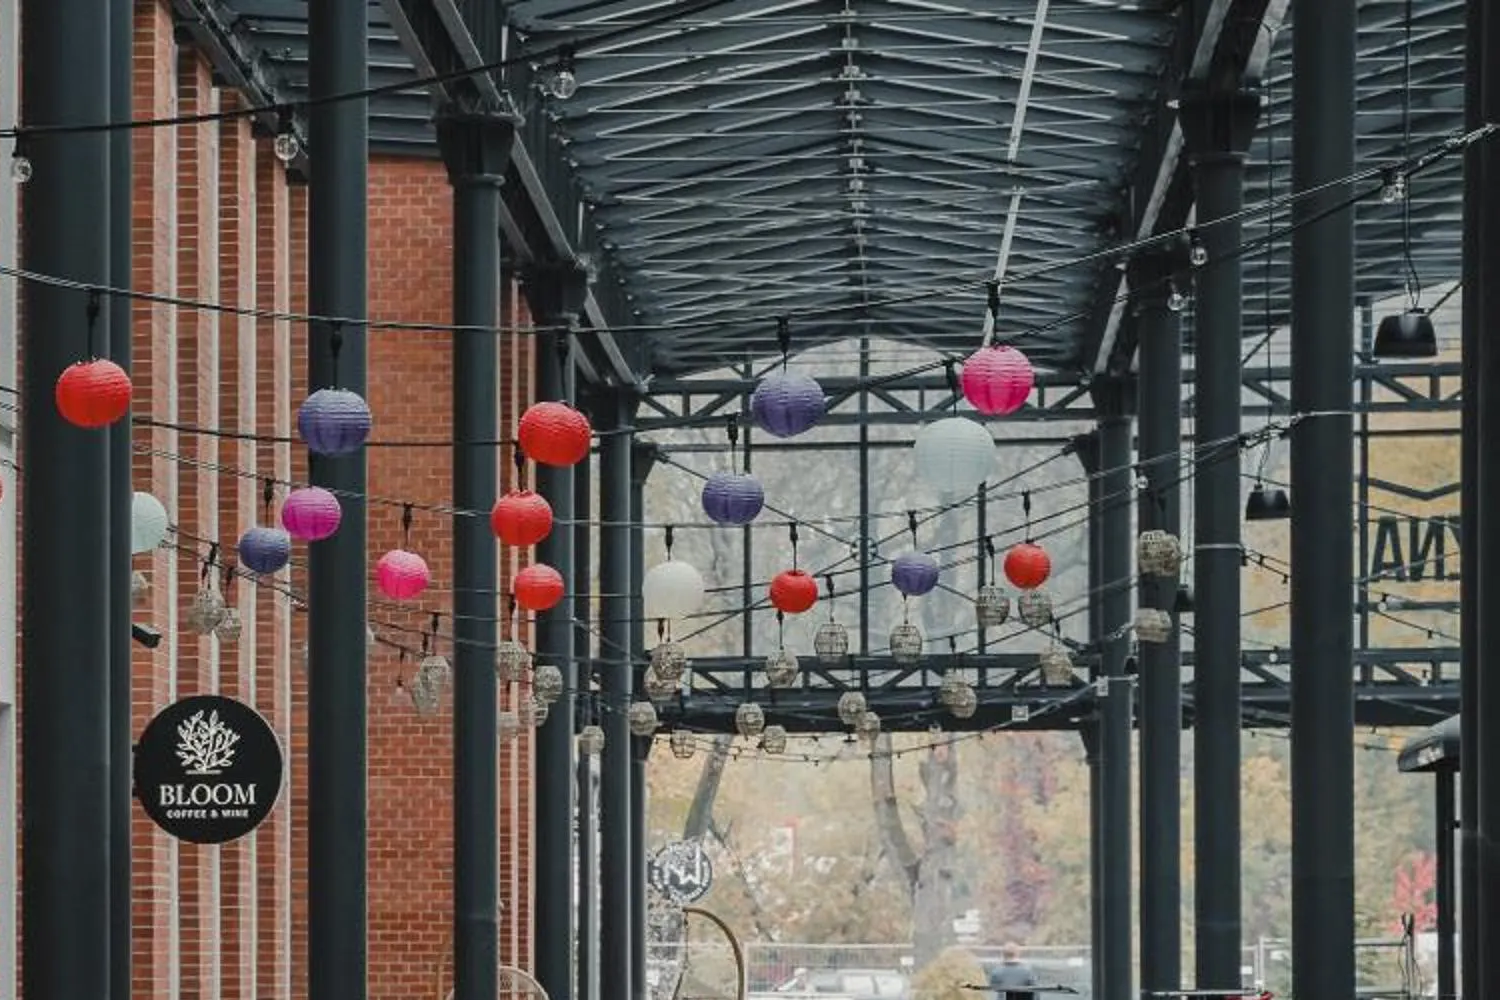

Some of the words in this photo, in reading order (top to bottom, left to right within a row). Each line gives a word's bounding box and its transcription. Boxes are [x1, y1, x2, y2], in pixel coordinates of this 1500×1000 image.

[160, 783, 257, 806] BLOOM
[166, 809, 207, 819] COFFEE
[210, 809, 219, 819] &
[221, 809, 249, 818] WINE
